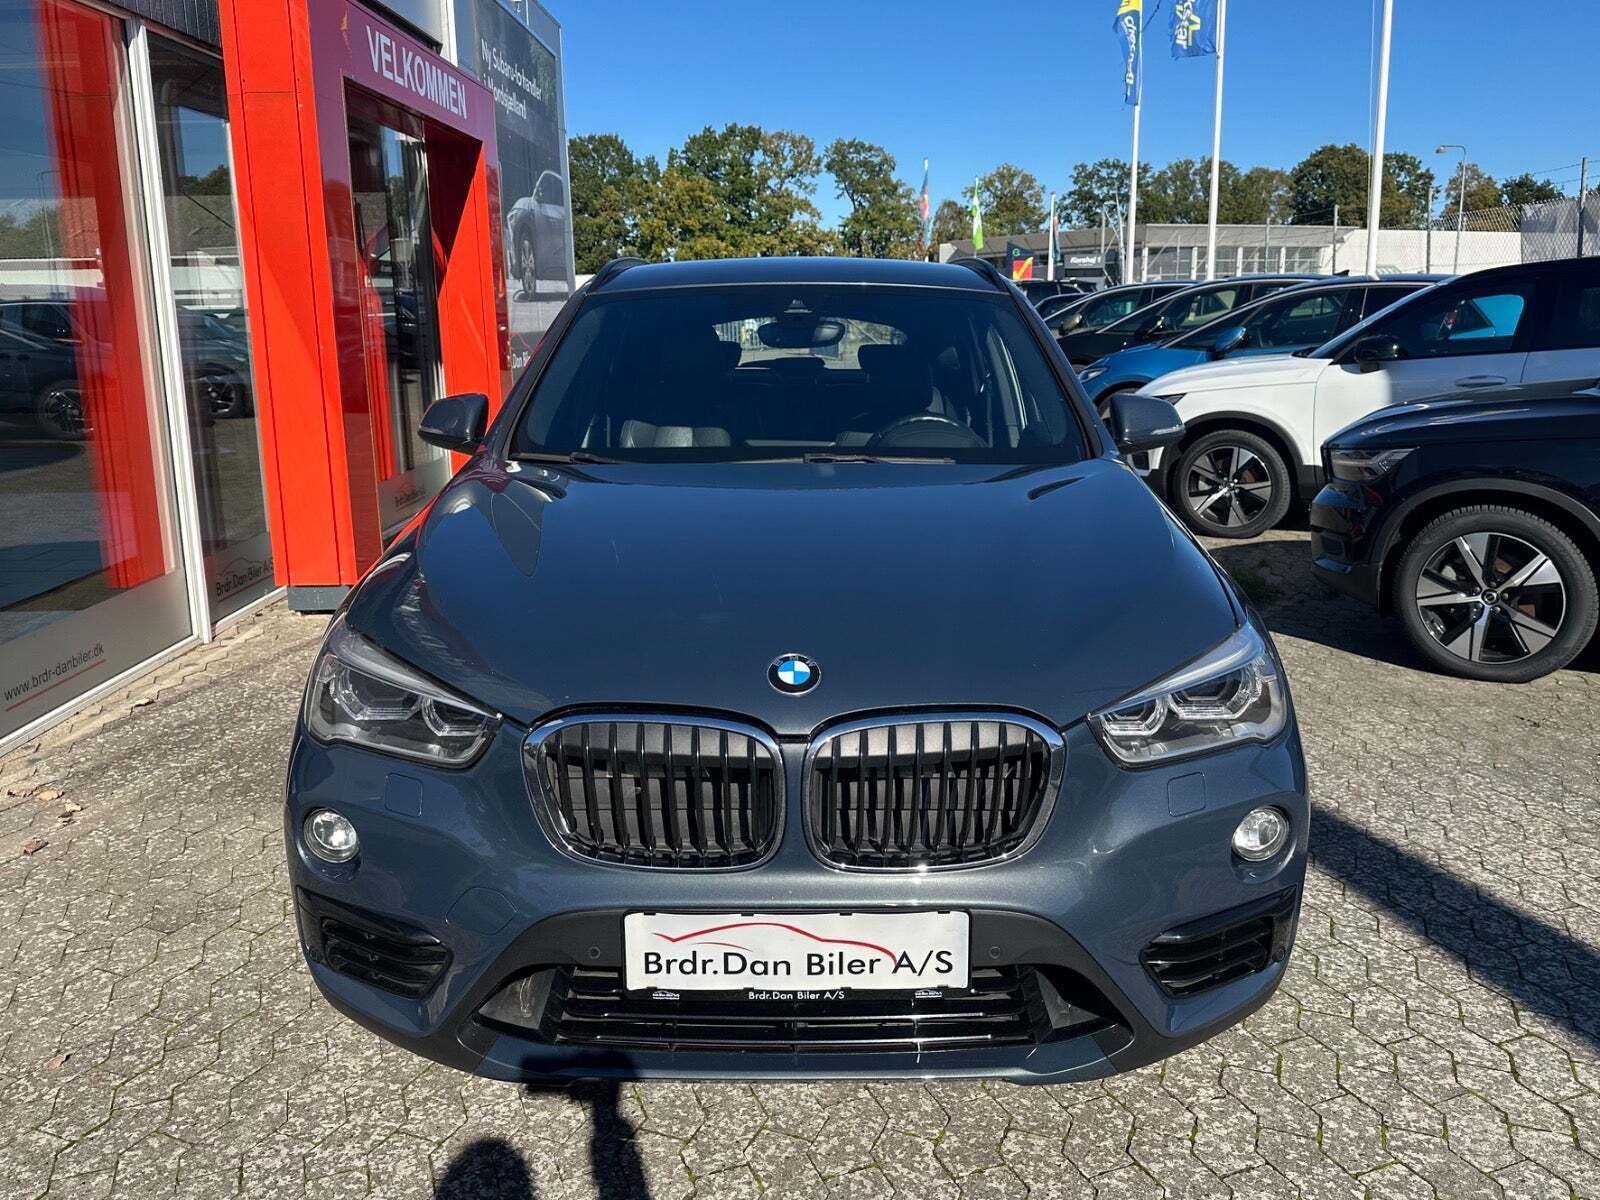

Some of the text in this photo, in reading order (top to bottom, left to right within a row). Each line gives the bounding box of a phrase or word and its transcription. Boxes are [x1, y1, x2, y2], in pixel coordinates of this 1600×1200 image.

[481, 39, 491, 70] Ny
[366, 25, 467, 119] VELKOMMEN
[3, 643, 105, 702] www.brdr-danbiler.dk
[807, 951, 881, 976] Biler
[892, 950, 953, 977] A/S
[796, 991, 821, 1000] Biler
[823, 991, 845, 1000] A/S
